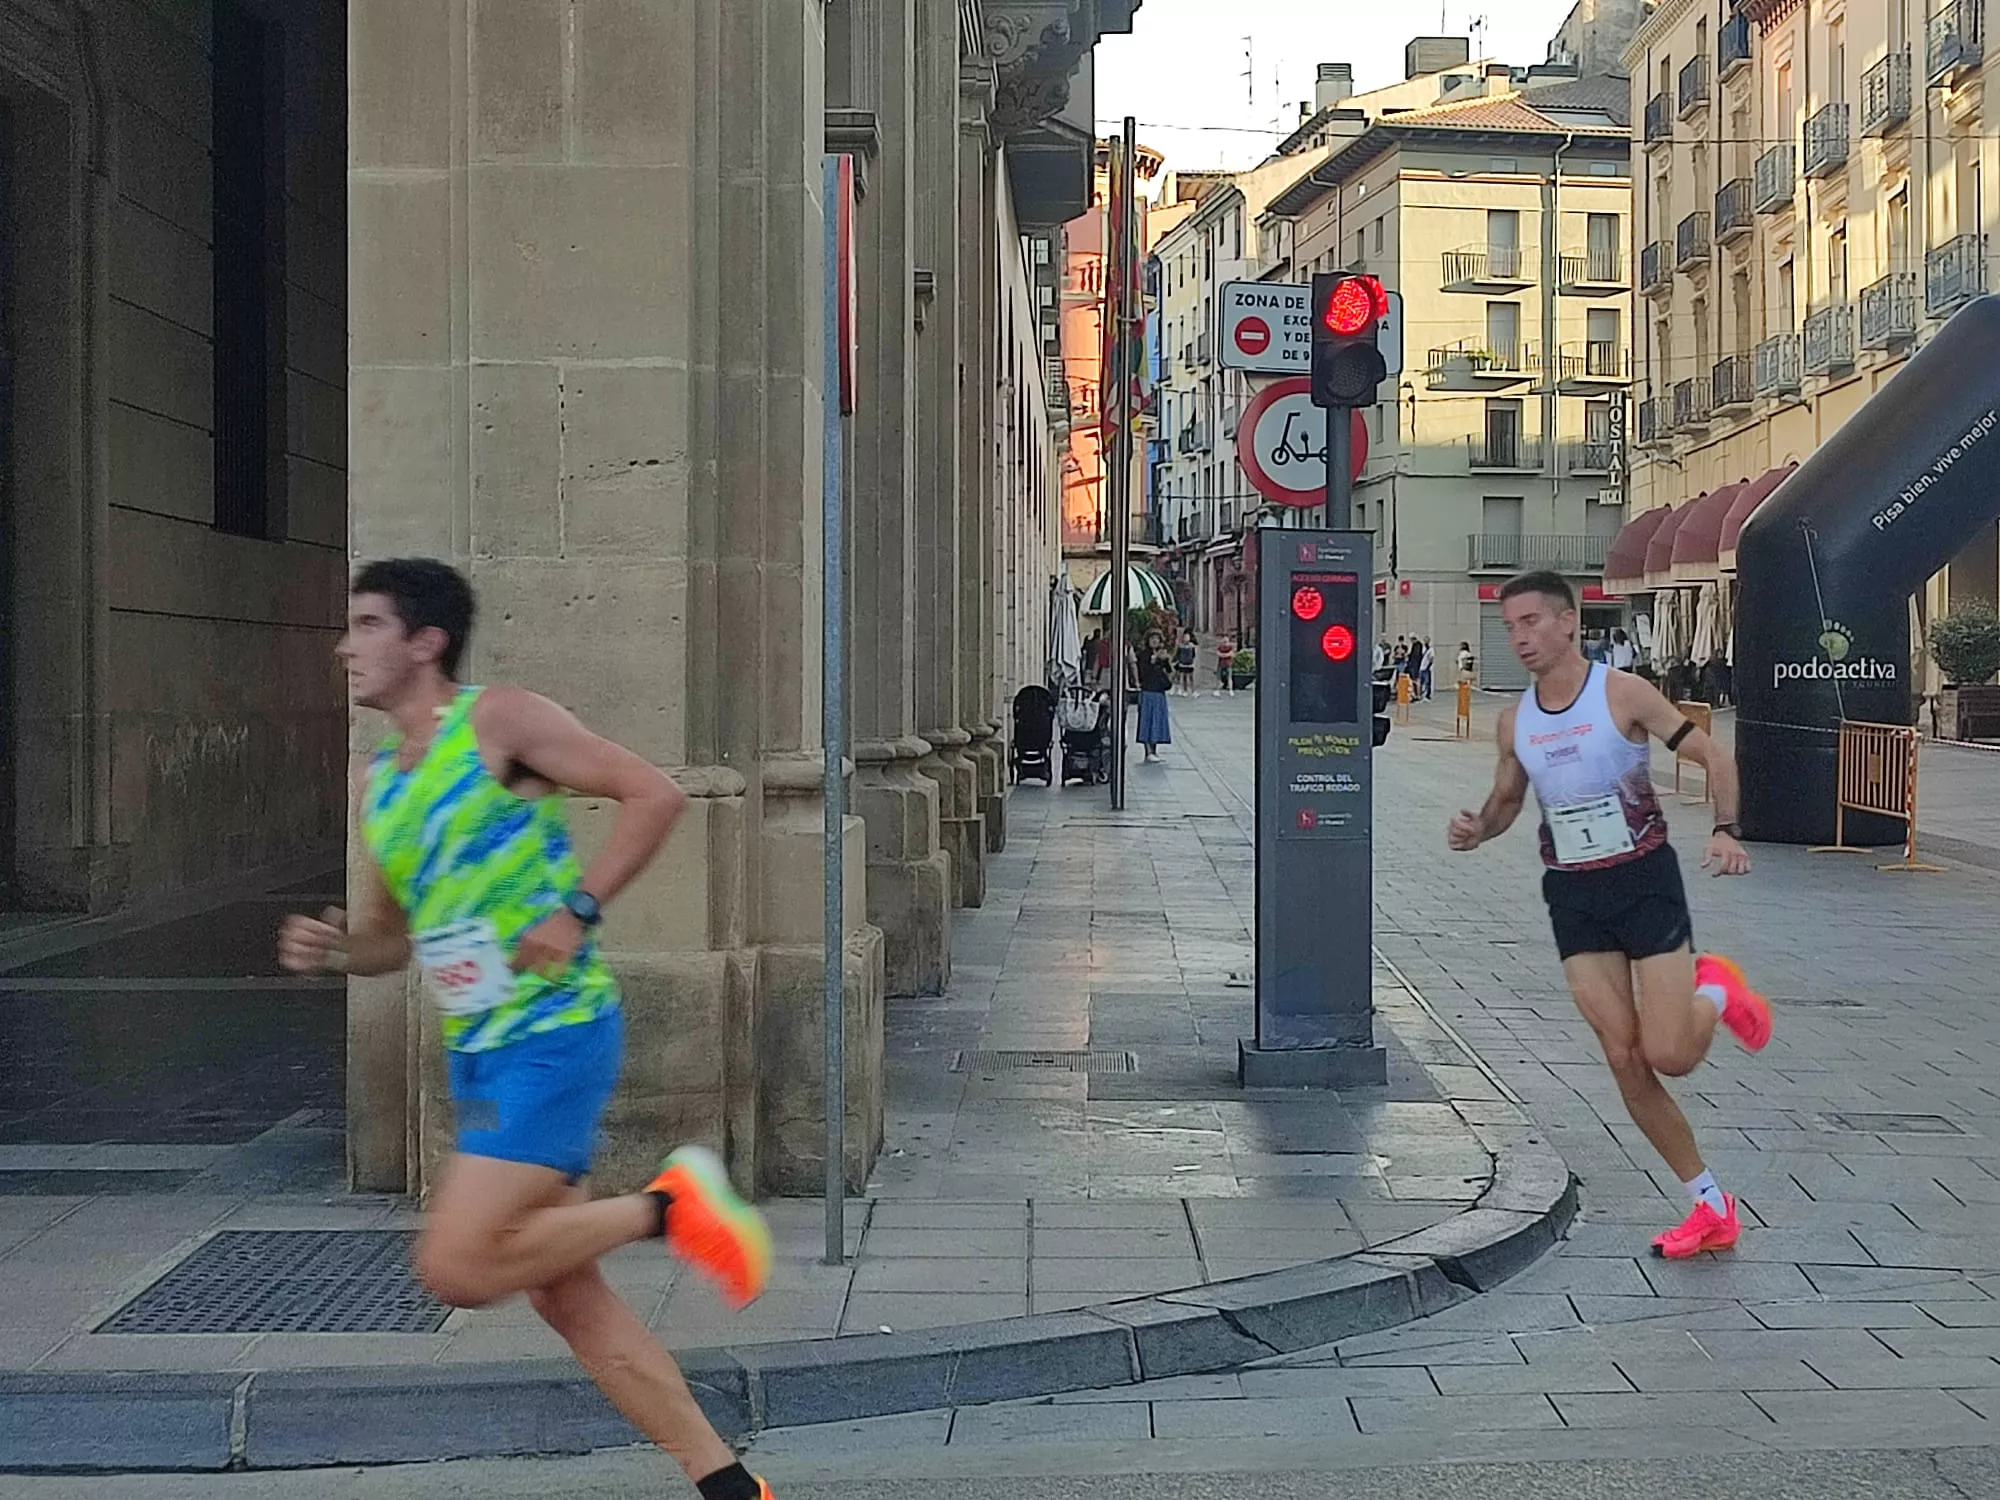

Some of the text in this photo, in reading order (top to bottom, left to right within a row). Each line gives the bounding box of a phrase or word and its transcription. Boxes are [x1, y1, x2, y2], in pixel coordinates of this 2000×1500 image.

[1235, 293, 1305, 309] ZONA DE
[1283, 315, 1312, 327] EXC
[1283, 331, 1291, 342] Y
[1282, 349, 1298, 360] DE
[1609, 391, 1622, 486] HOSTAL
[1871, 410, 1998, 531] Pisa bien, vive mejor
[1774, 655, 1896, 689] podoactiva
[1296, 774, 1353, 783] CONTROL DEL
[1289, 783, 1361, 793] TRAFICO RODADO
[1581, 827, 1593, 843] 1
